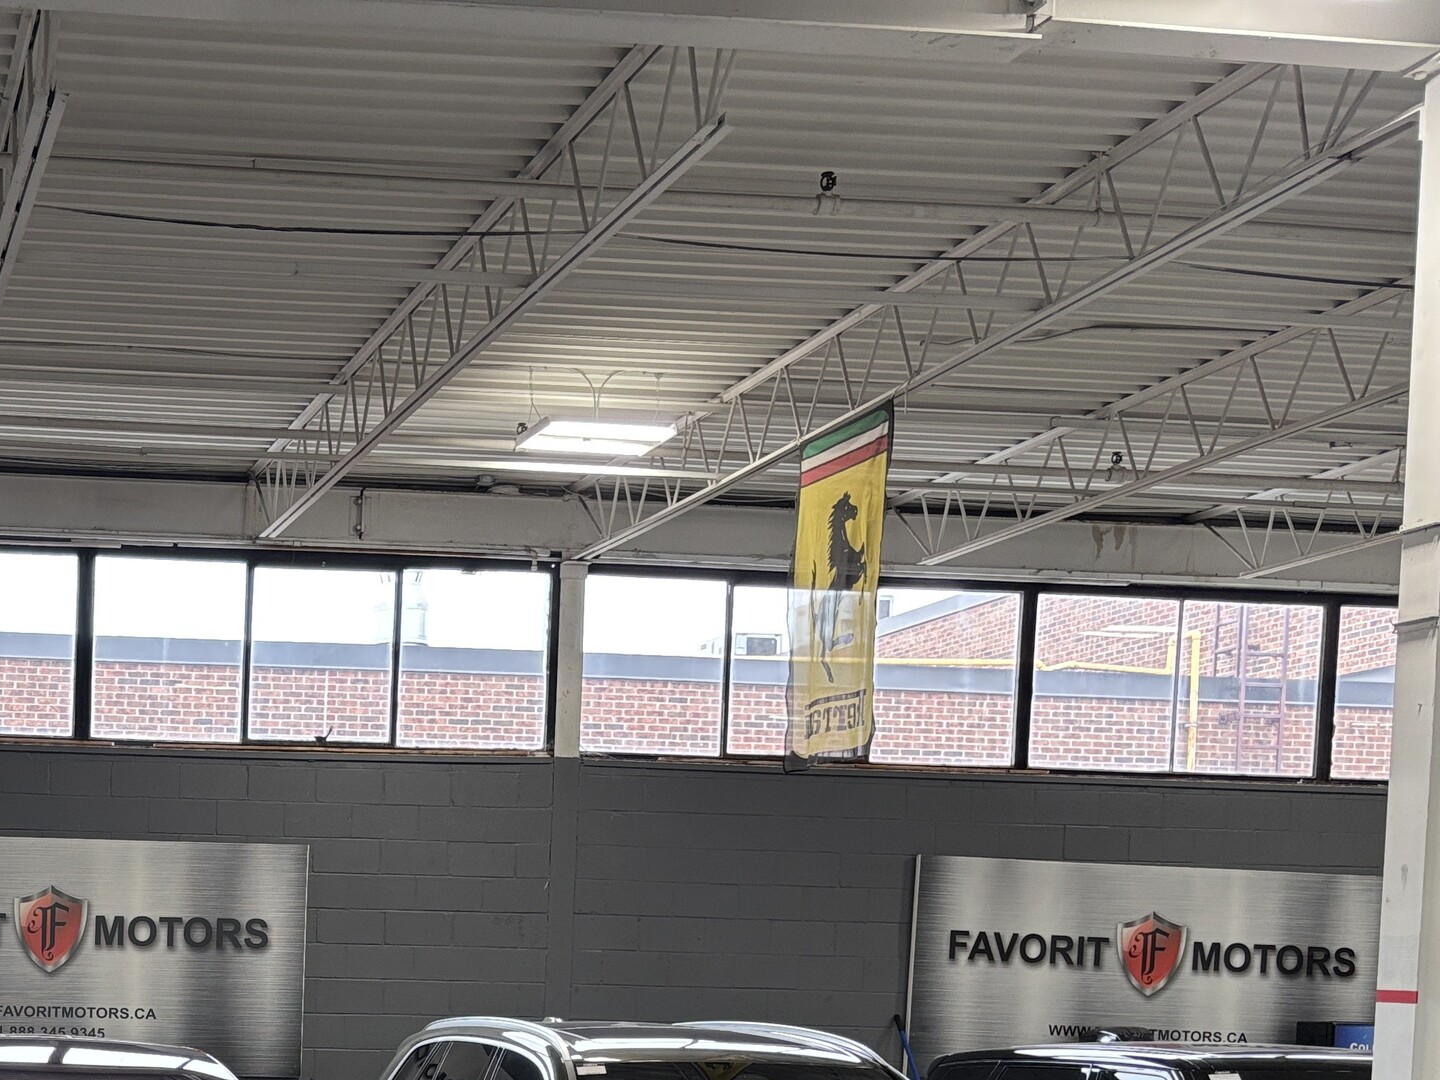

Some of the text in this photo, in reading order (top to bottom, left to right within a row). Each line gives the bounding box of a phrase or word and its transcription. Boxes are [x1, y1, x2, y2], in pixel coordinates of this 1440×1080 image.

[94, 914, 270, 951] MOTORS
[948, 929, 1110, 968] FAVORIT
[1191, 940, 1357, 979] MOTORS
